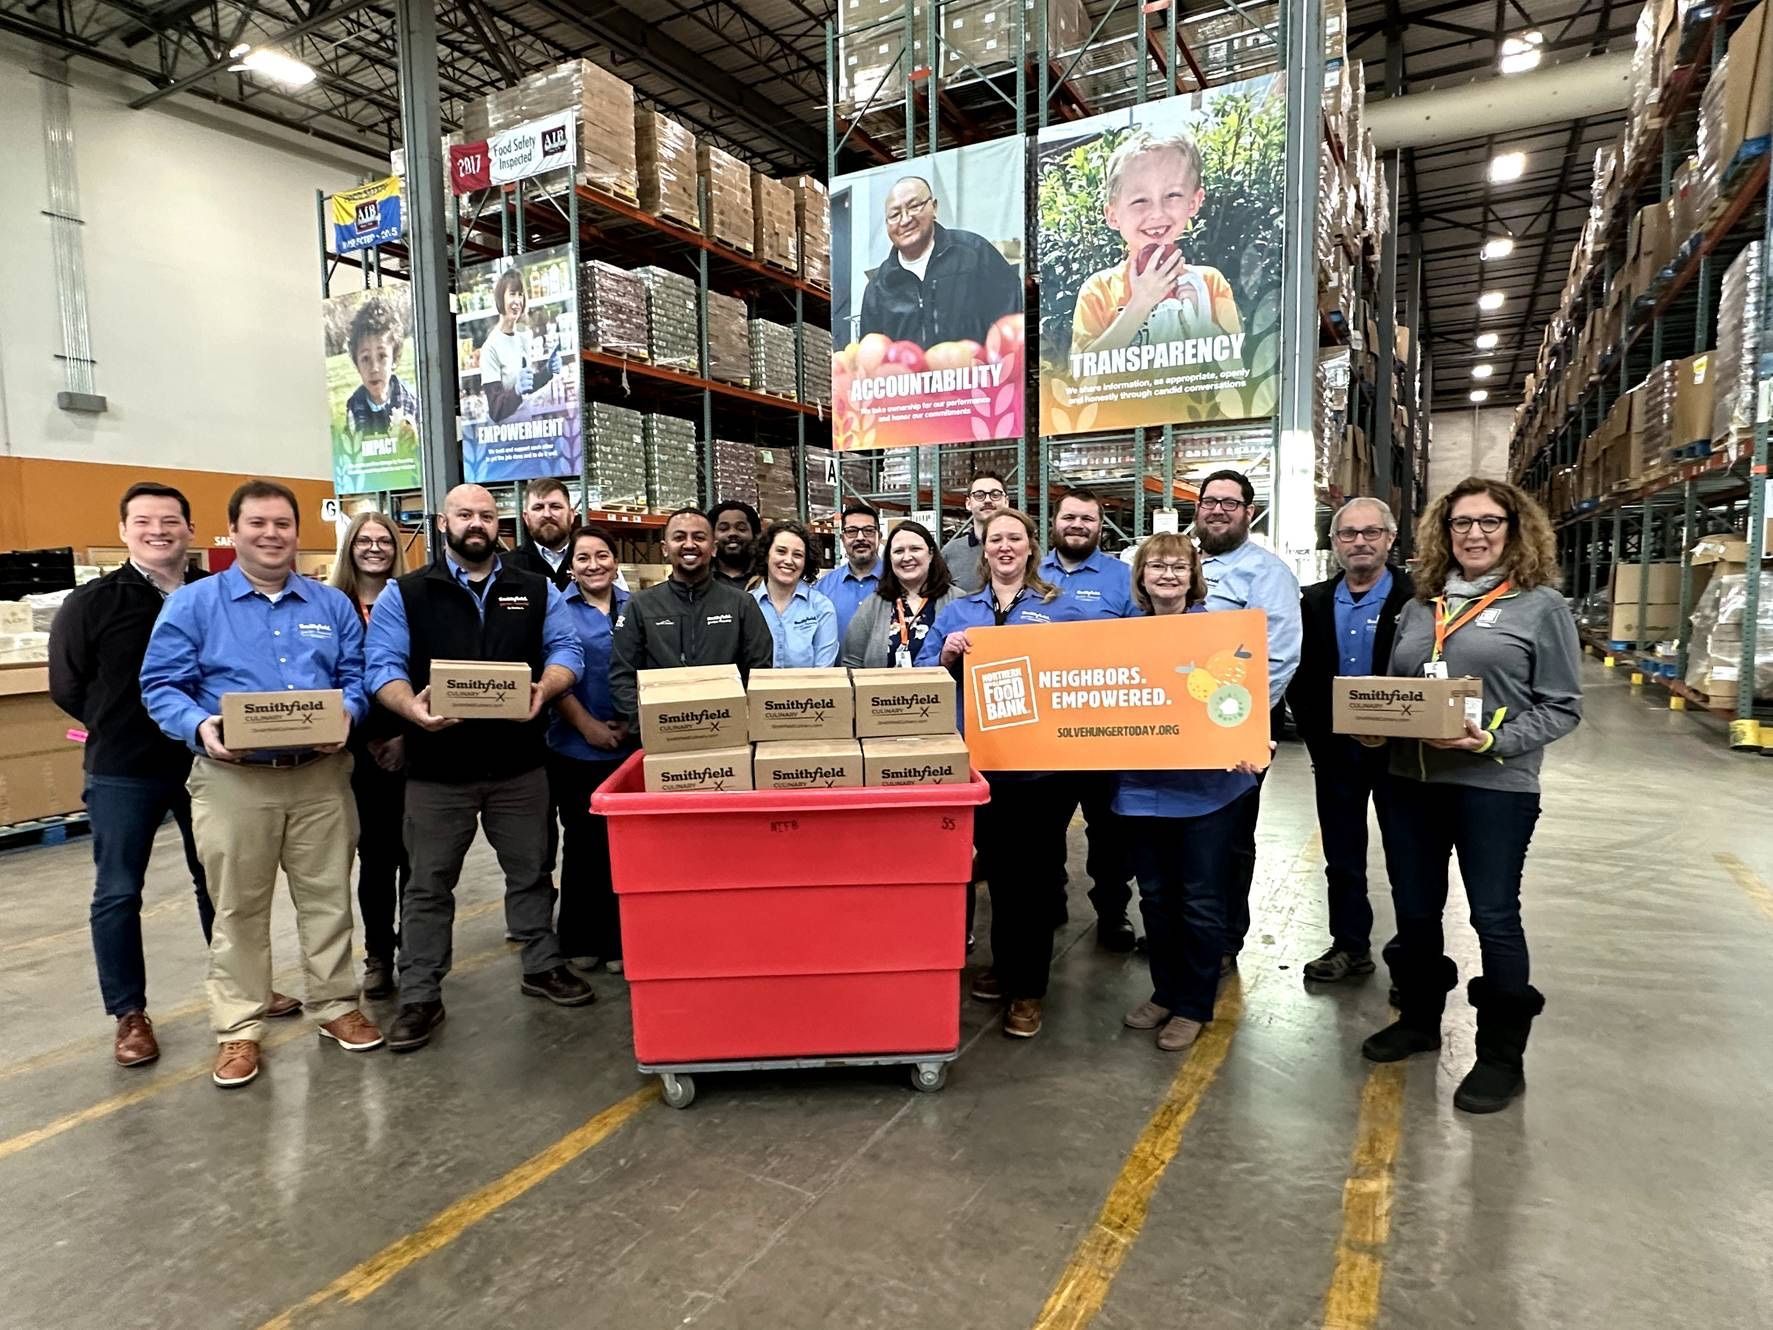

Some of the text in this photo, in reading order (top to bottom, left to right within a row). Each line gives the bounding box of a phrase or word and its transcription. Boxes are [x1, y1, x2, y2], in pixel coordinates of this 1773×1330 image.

[493, 134, 536, 157] Food Safety
[457, 155, 481, 177] 2017
[499, 150, 532, 171] Inspected
[1070, 333, 1246, 378] TRANSPARENCY
[851, 363, 1002, 401] ACCOUNTABILITY
[1065, 387, 1077, 395] We
[1079, 385, 1101, 393] share
[1103, 379, 1152, 391] information,
[1166, 372, 1218, 384] appropriate,
[1220, 368, 1250, 379] openly
[1084, 393, 1118, 403] honestly
[1120, 389, 1152, 399] through
[1154, 386, 1182, 395] candid
[1184, 380, 1246, 392] conversations
[887, 402, 921, 413] ownership
[922, 401, 932, 409] for
[946, 397, 991, 408] performance
[892, 413, 911, 421] honor
[925, 408, 971, 418] commitments
[478, 417, 565, 444] EMPOWERMENT
[362, 437, 398, 456] IMPACT
[827, 459, 837, 483] A
[325, 501, 336, 517] G
[214, 536, 235, 546] SAF
[447, 679, 517, 693] Smithfield
[1039, 667, 1147, 688] NEIGHBORS.
[984, 677, 1025, 703] FOOD
[1051, 688, 1172, 709] EMPOWERED.
[1349, 690, 1426, 705] Smithfield
[244, 701, 324, 715] Smithfield
[765, 698, 835, 713] Smithfield
[871, 694, 941, 709] Smithfield
[658, 709, 732, 725] Smithfield
[1057, 725, 1180, 738] SOLVEHUNGERTODAY.ORG
[661, 767, 736, 784] Smithfield
[773, 767, 846, 783] Smithfield
[881, 765, 955, 781] Smithfield
